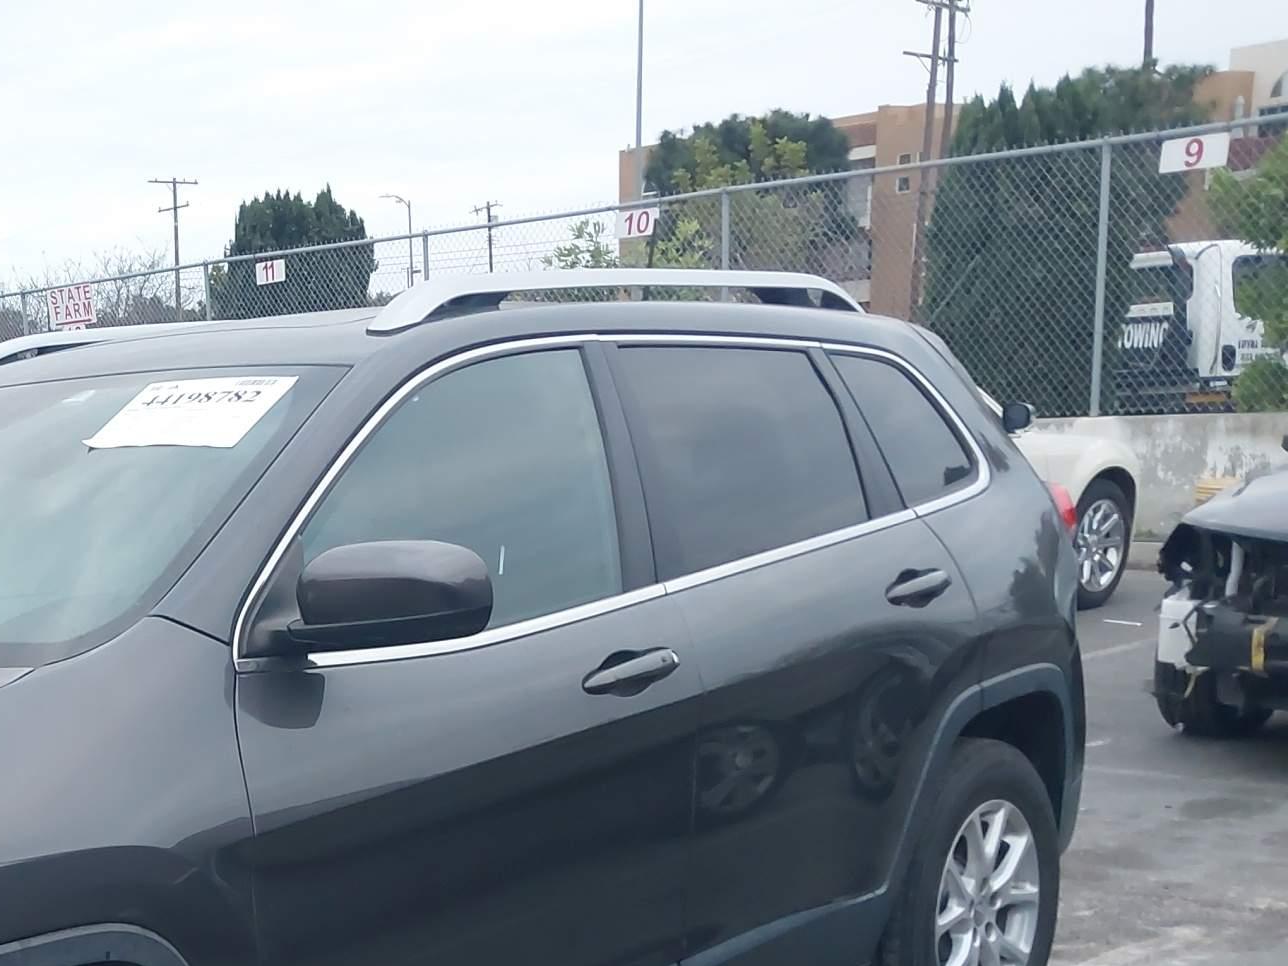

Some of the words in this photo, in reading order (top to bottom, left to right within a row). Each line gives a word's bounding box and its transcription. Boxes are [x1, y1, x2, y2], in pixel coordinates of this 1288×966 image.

[1184, 138, 1204, 168] 9
[624, 211, 650, 235] 10
[262, 261, 275, 282] 11
[50, 285, 91, 305] STATE
[54, 301, 93, 320] FARM
[141, 390, 262, 407] 44198782
